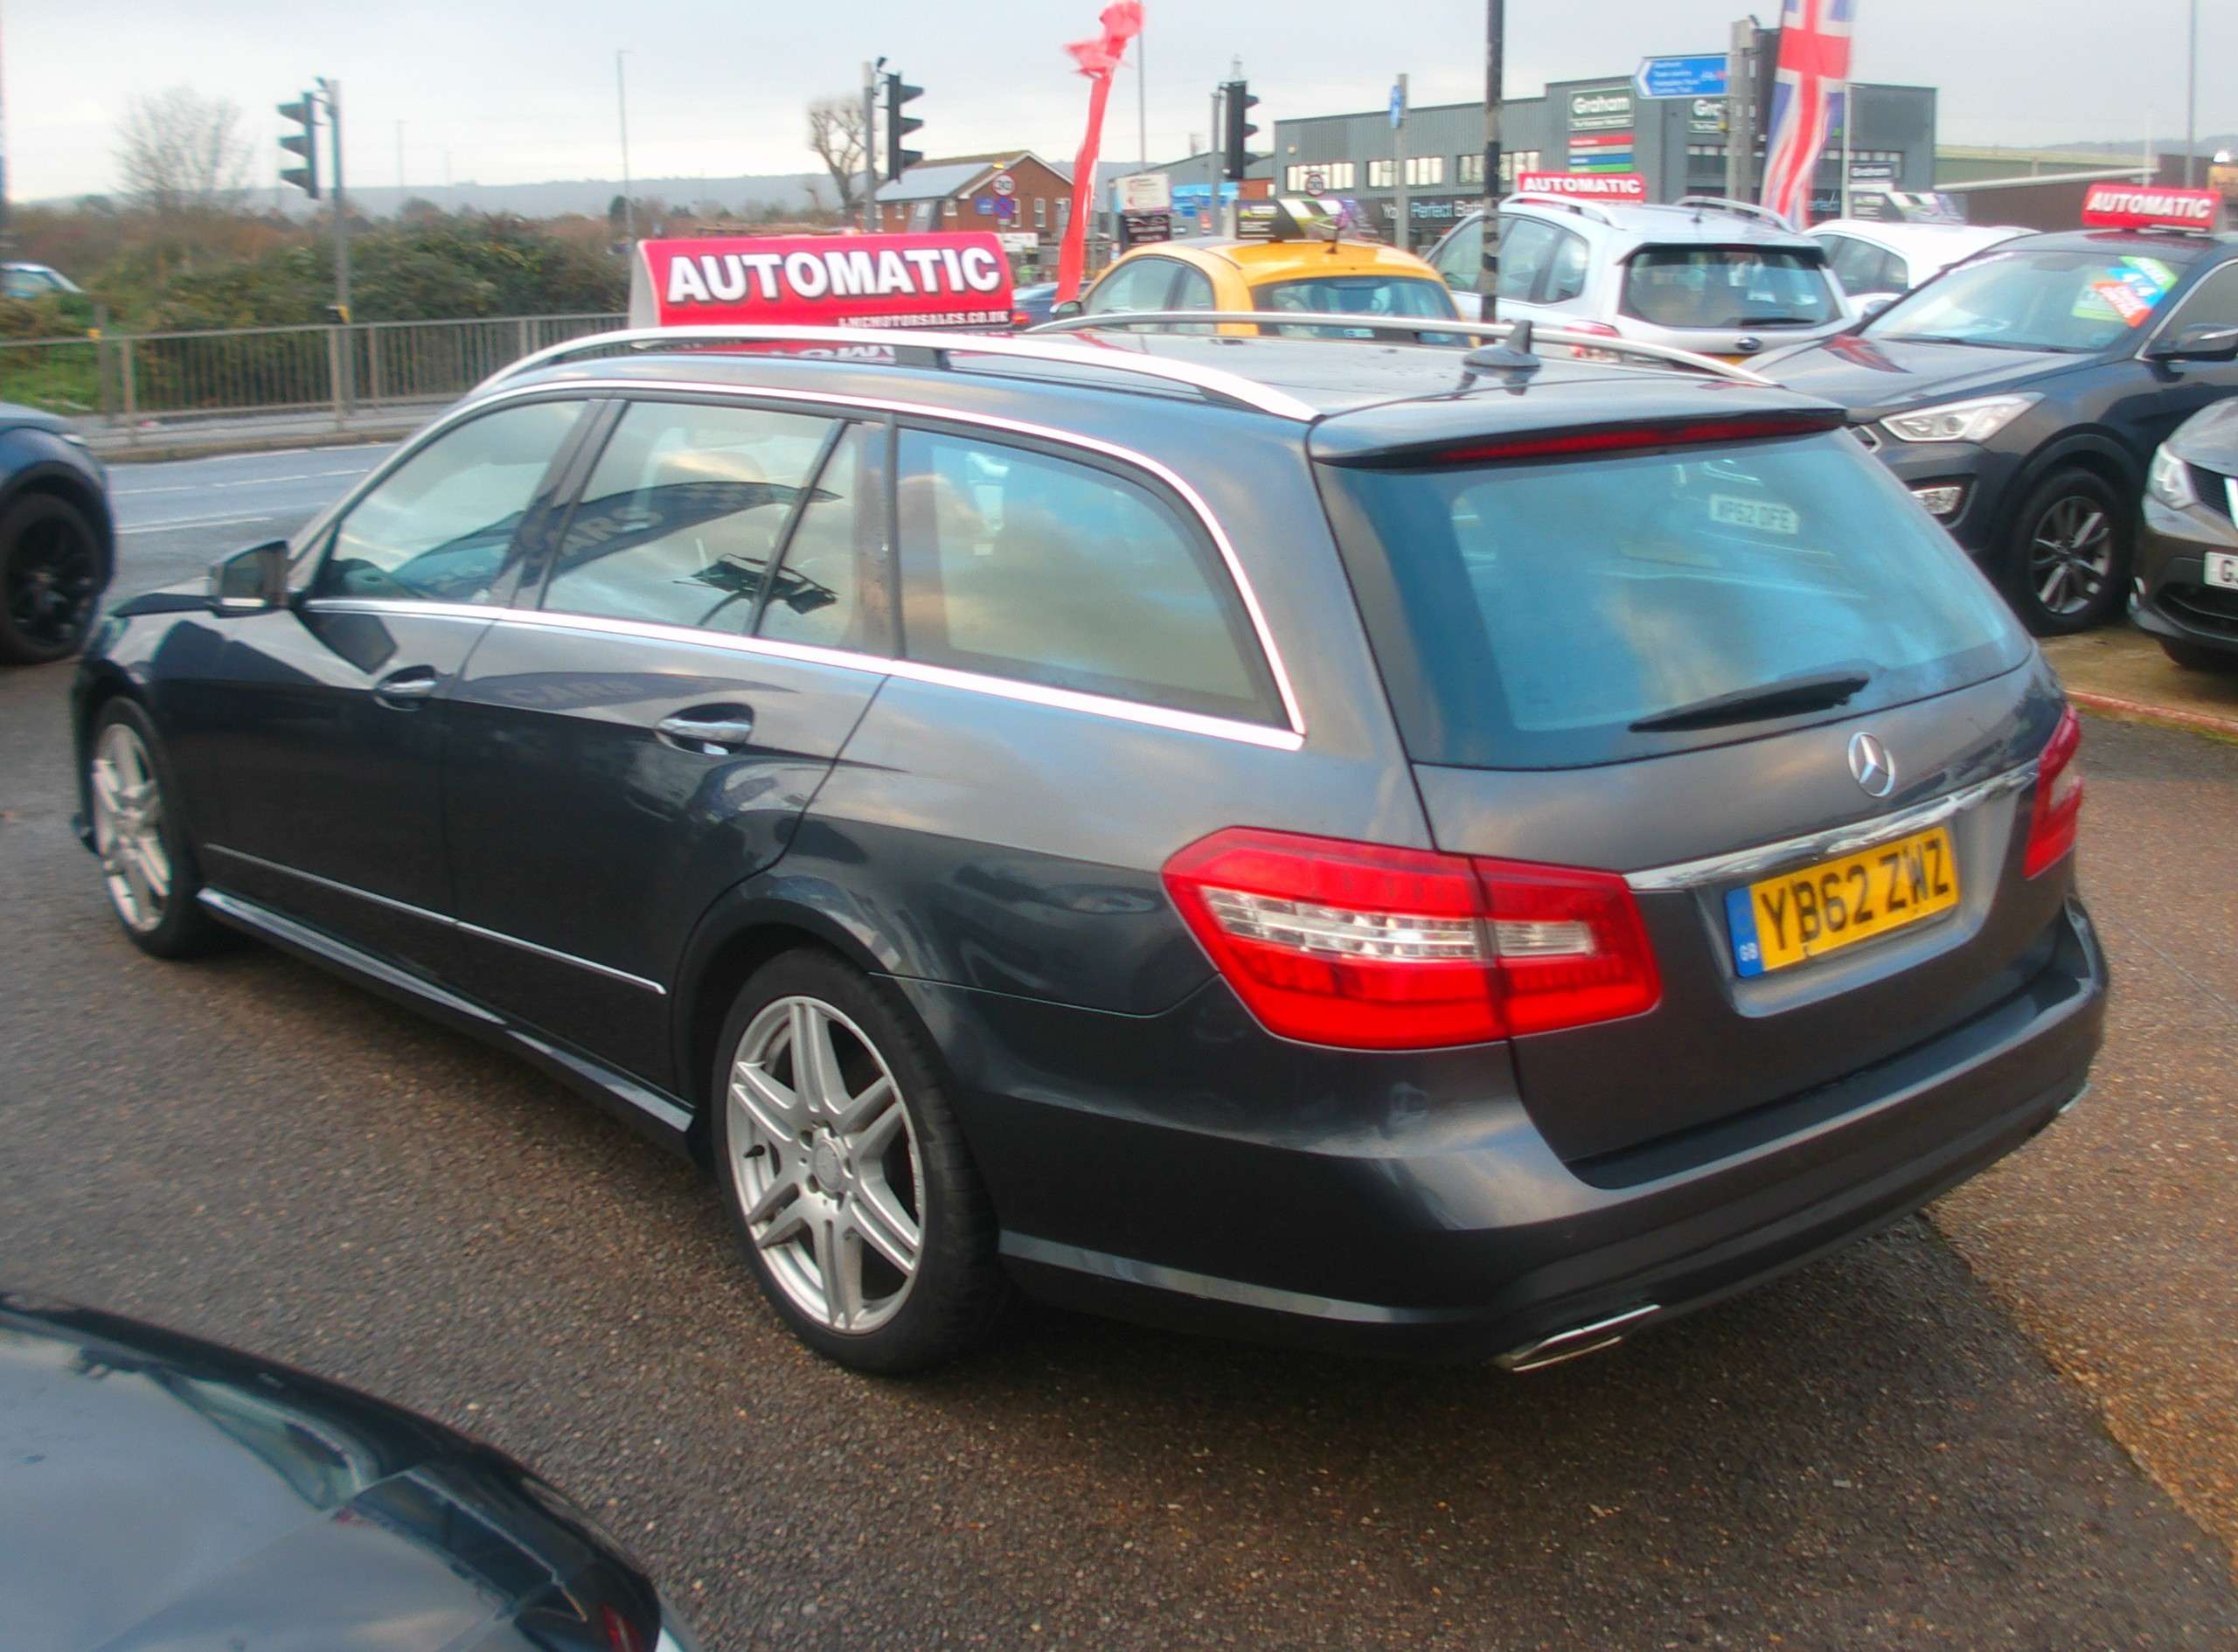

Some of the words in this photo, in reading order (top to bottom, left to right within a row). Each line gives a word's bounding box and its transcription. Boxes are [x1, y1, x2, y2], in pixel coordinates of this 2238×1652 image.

[1523, 177, 1642, 194] AUTOMATIC
[2086, 191, 2211, 219] AUTOMATIC
[666, 246, 1002, 303] AUTOMATIC
[1761, 864, 1873, 951] YB62
